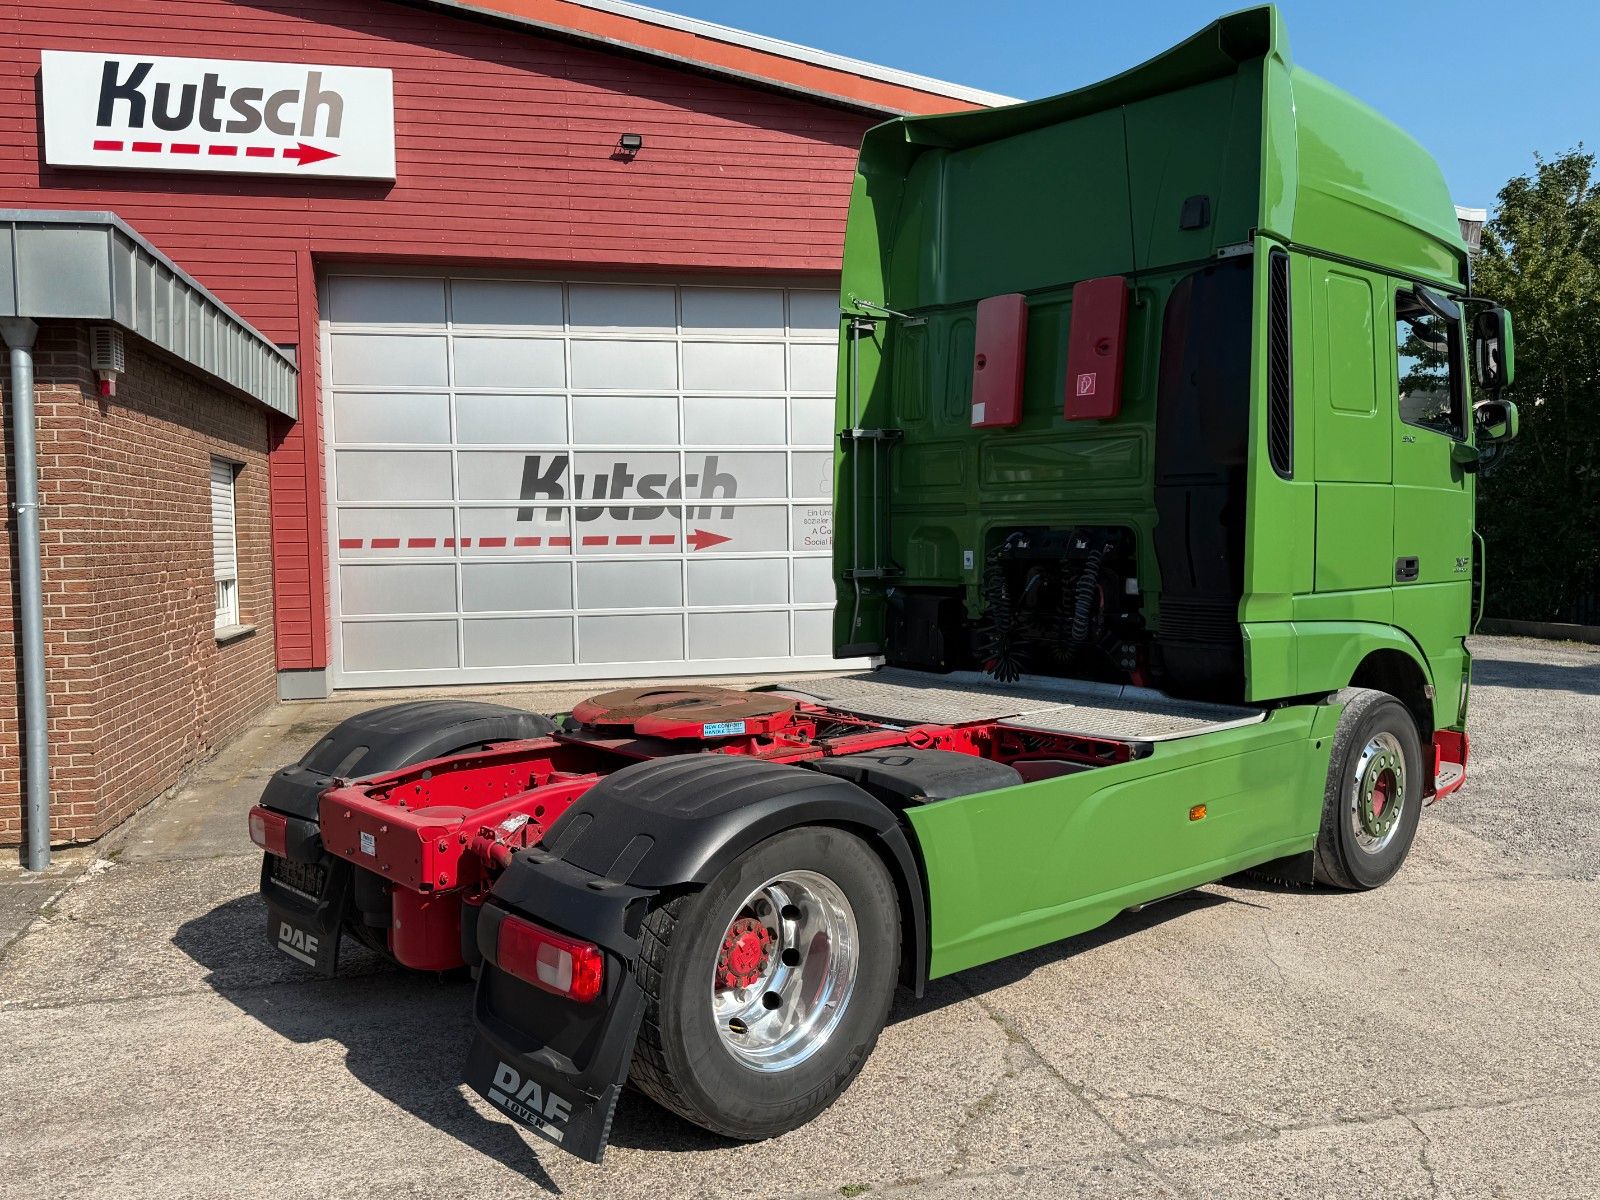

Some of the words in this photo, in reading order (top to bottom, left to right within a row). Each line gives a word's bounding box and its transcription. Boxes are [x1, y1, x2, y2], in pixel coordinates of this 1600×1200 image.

[96, 60, 344, 138] Kutsch
[516, 455, 738, 522] Kutsch
[804, 537, 827, 545] Social
[279, 920, 319, 954] DAF
[492, 1060, 573, 1123] DAF
